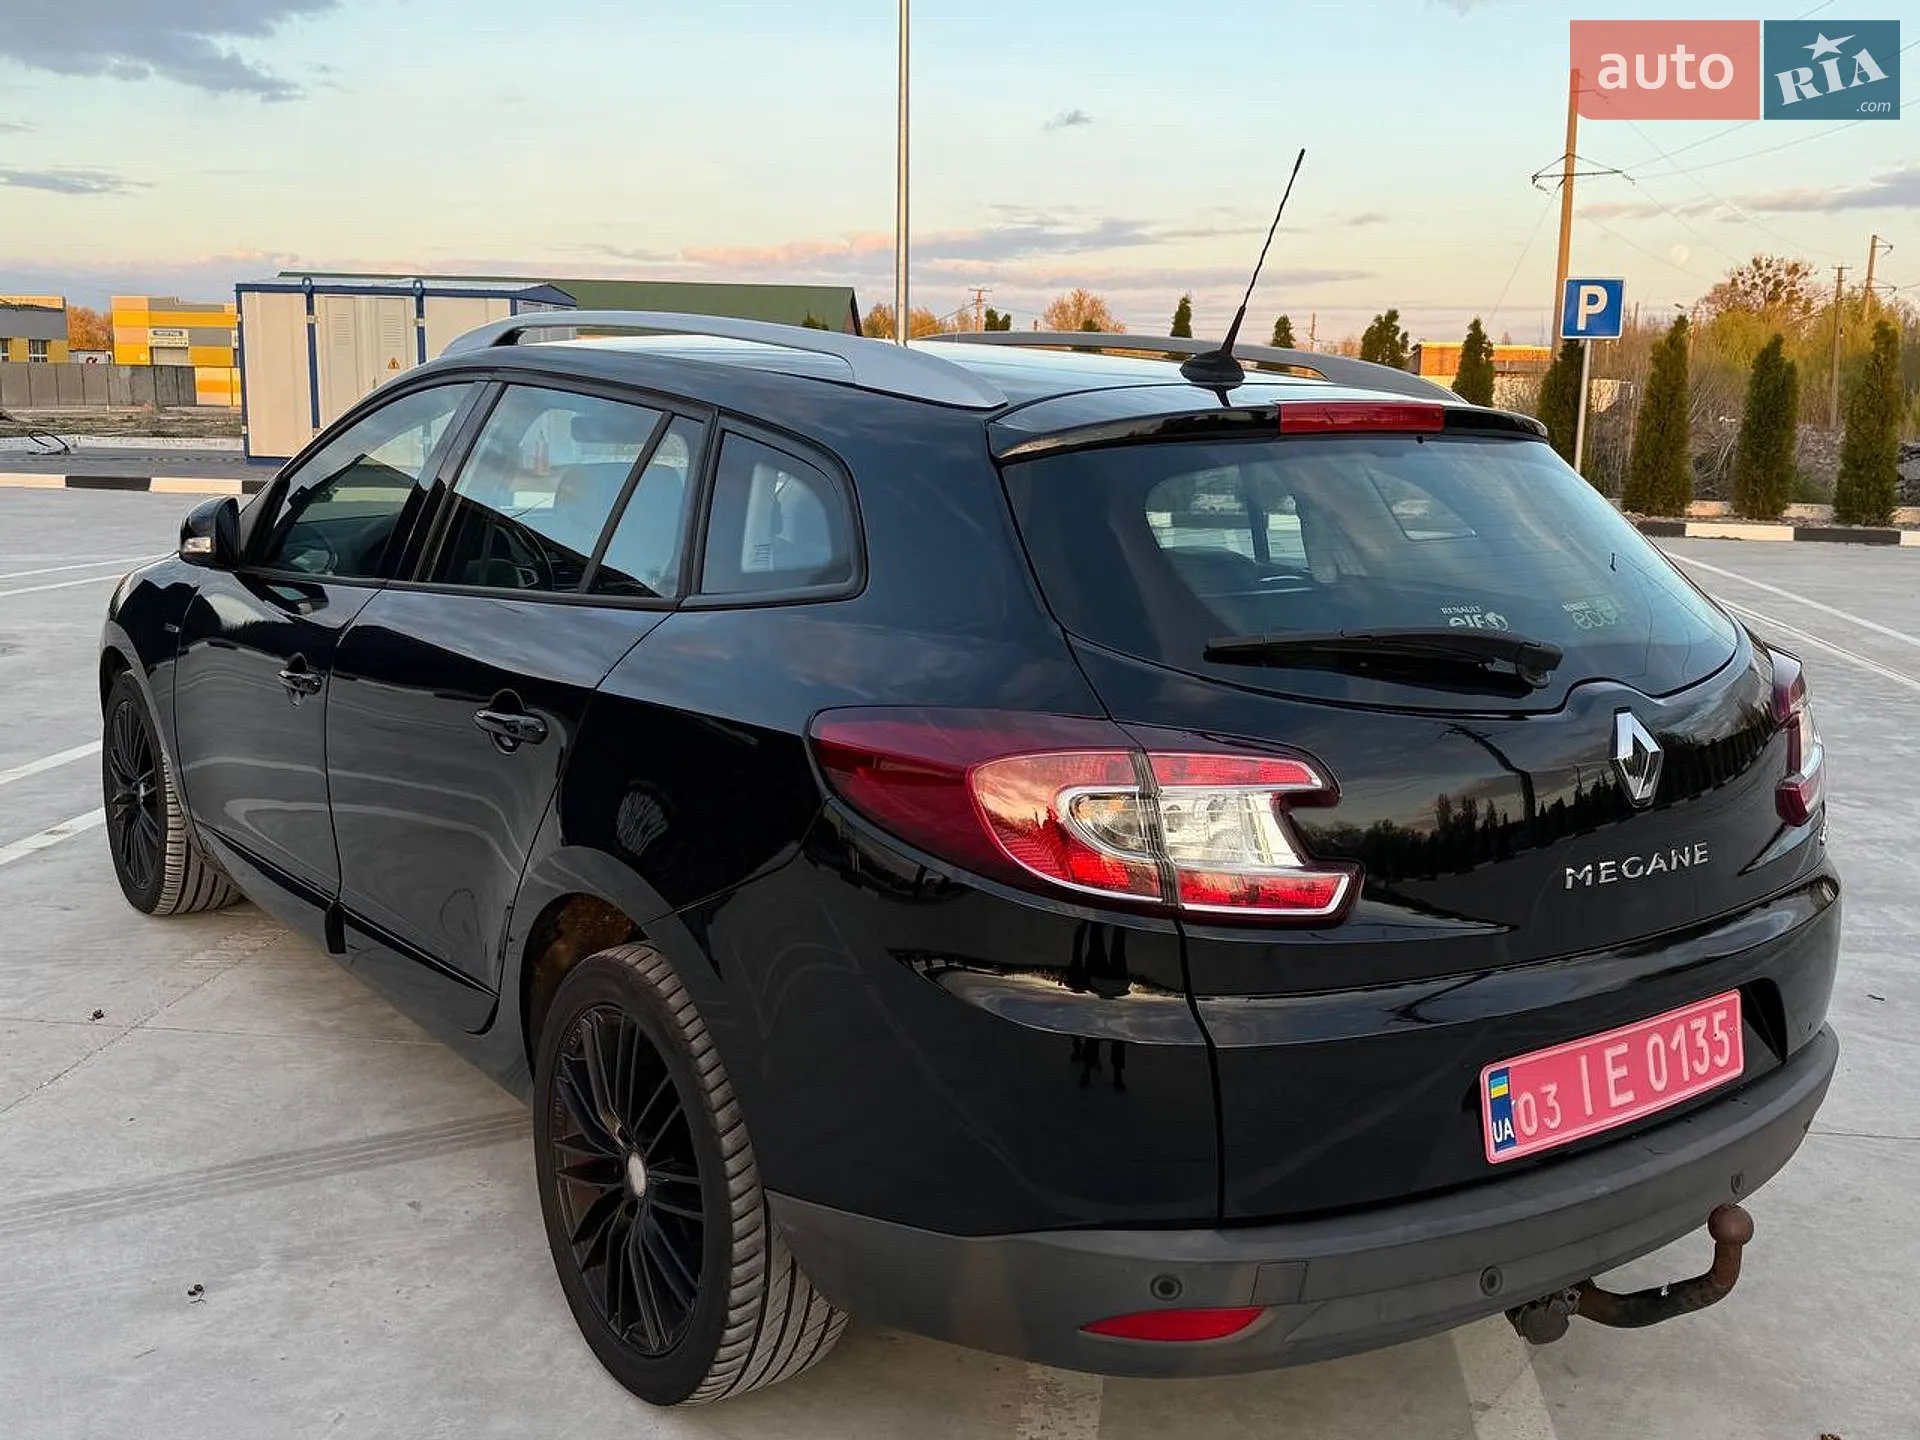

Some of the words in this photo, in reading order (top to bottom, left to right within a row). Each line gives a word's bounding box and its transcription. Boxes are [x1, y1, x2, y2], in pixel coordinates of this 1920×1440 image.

[1576, 285, 1608, 331] P
[1564, 841, 1710, 890] MEGANE
[1514, 1081, 1562, 1137] 03
[1579, 1042, 1635, 1117] IE
[1646, 1009, 1731, 1093] 0135
[1492, 1117, 1515, 1144] UA
